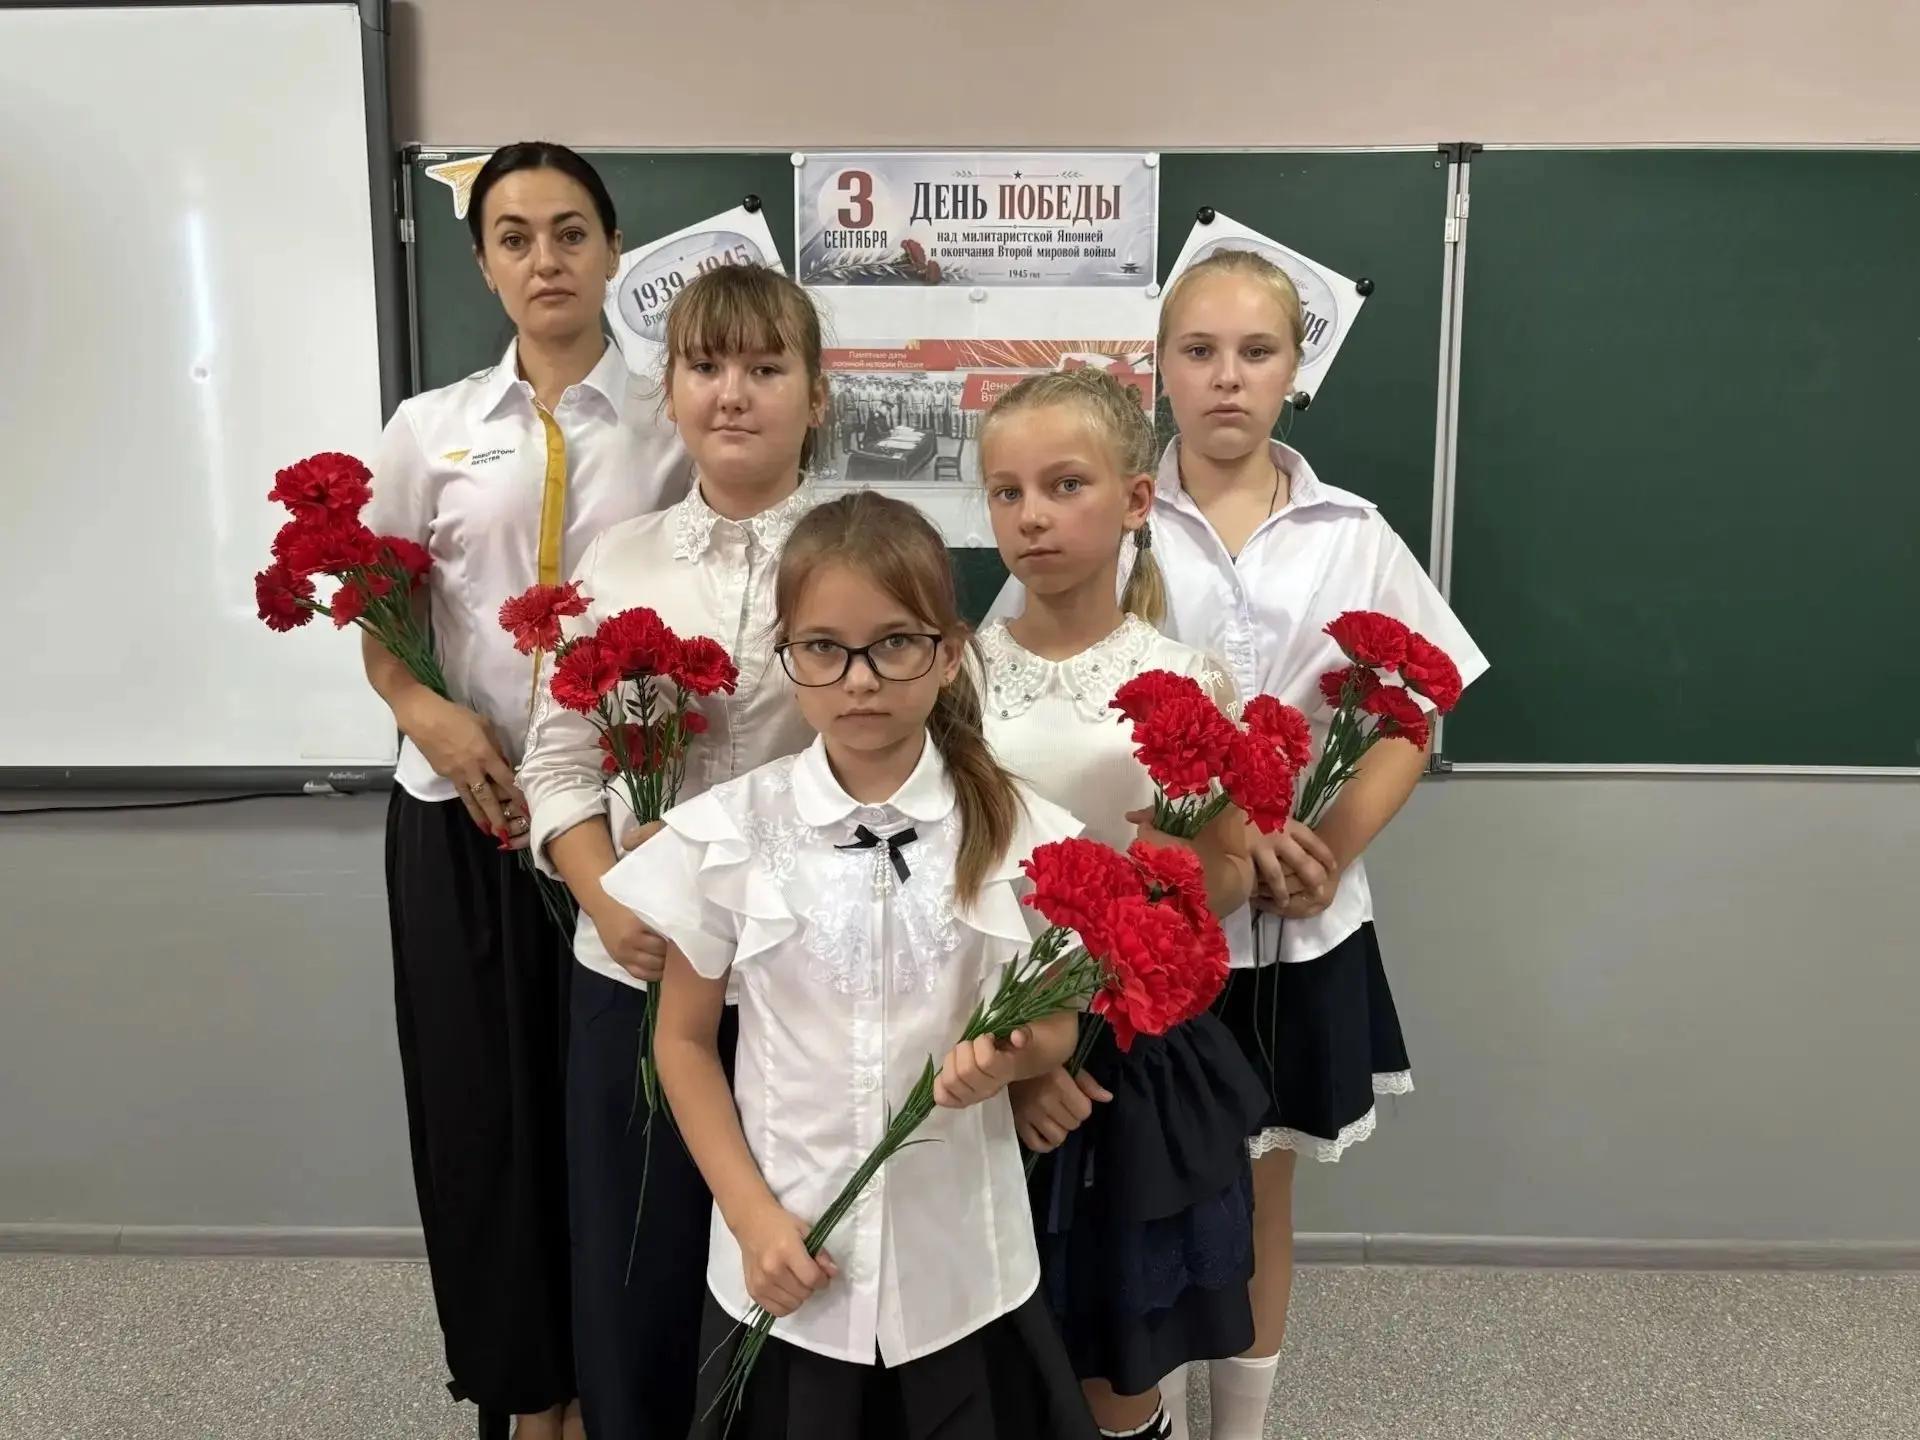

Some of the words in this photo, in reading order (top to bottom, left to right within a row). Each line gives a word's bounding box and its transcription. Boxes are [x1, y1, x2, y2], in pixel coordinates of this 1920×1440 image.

[837, 170, 874, 230] 3
[910, 182, 988, 226] ДЕНЬ
[998, 183, 1121, 227] ПОБЕДЫ
[824, 229, 888, 250] СЕНТЯБРЯ
[937, 231, 958, 243] над
[962, 230, 1053, 245] милитаристской
[1057, 230, 1103, 243] Японией
[930, 248, 937, 257] и
[941, 247, 994, 257] окончания
[998, 245, 1032, 260] Второй
[1037, 246, 1080, 260] мировой
[1083, 246, 1116, 258] войны
[1009, 269, 1028, 278] 1945
[849, 350, 887, 360] Памятные
[888, 352, 907, 360] даты
[866, 361, 896, 369] истории
